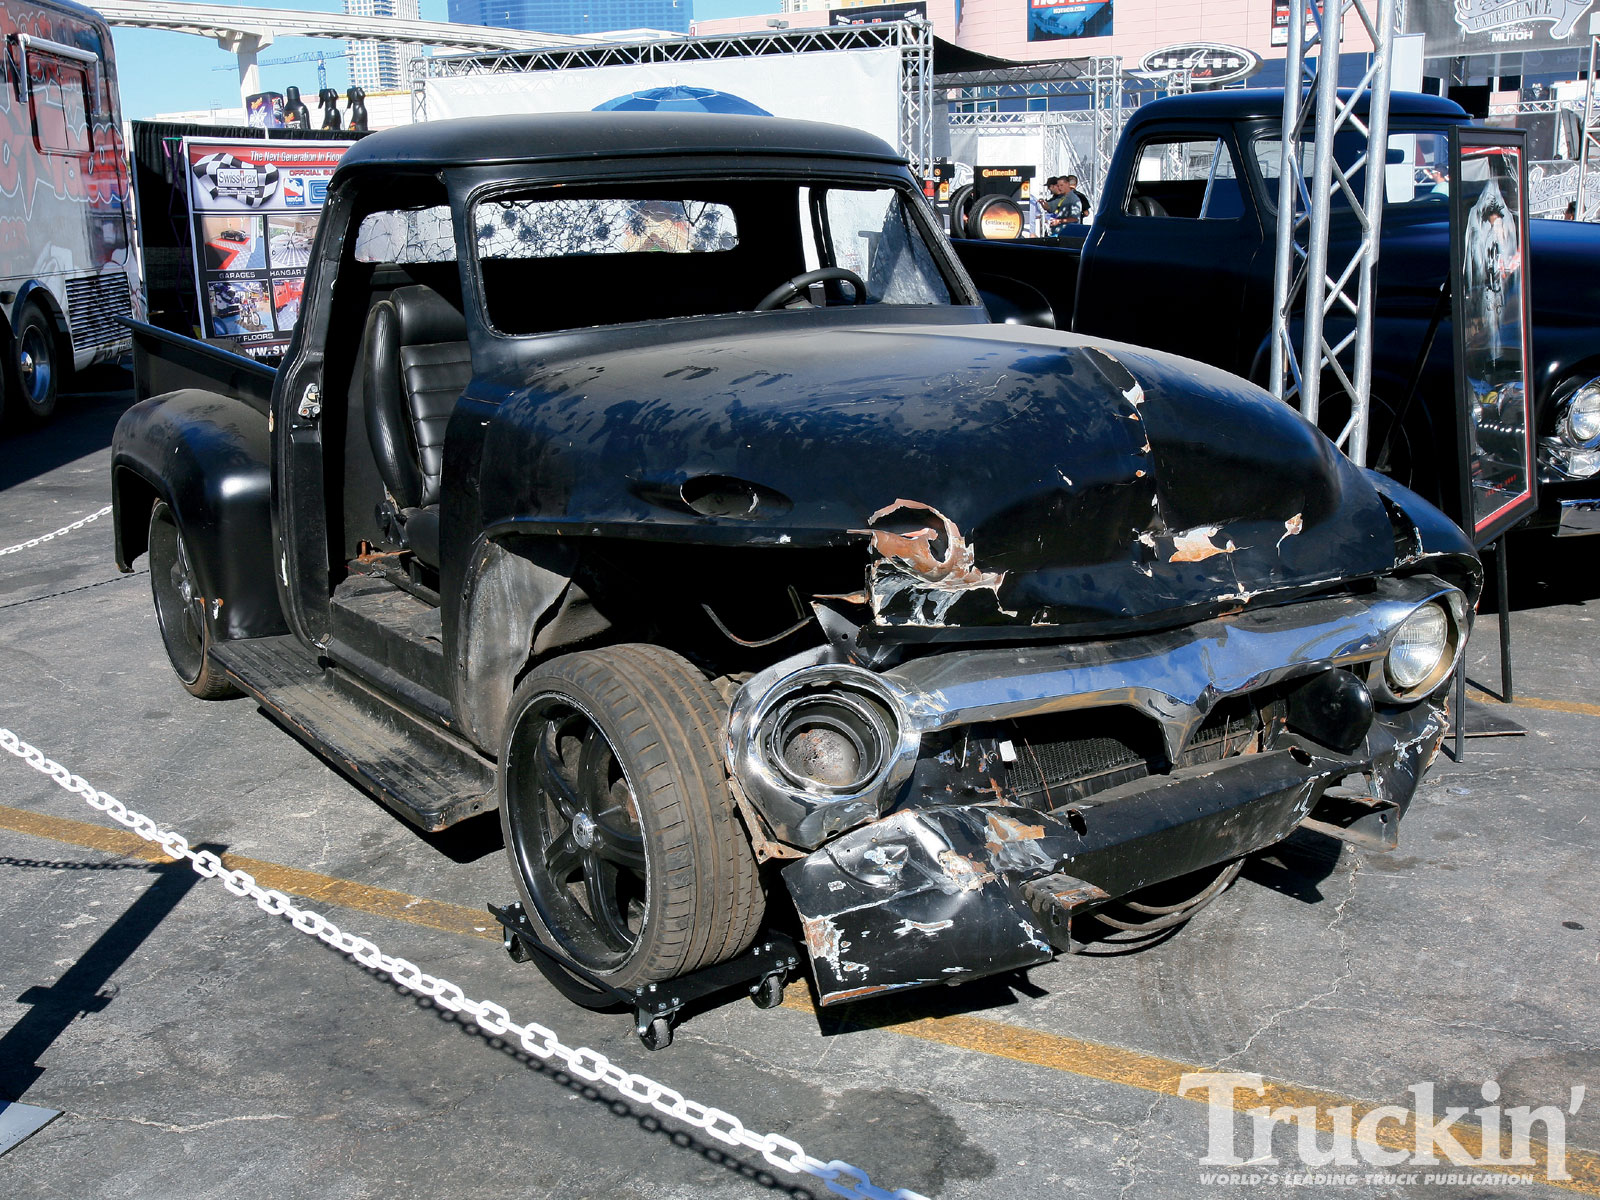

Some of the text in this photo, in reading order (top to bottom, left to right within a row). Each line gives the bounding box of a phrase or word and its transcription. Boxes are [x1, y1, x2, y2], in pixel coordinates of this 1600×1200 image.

[1474, 0, 1552, 28] EXPERIENCE
[1491, 30, 1533, 42] MUTOH
[1153, 58, 1240, 69] FESLER
[251, 150, 263, 162] The
[264, 151, 279, 163] Next
[281, 151, 317, 163] Generation
[318, 152, 325, 162] In
[289, 169, 321, 177] OFFICIAL
[982, 169, 1017, 178] Continental
[219, 271, 256, 279] GARAGES
[243, 333, 274, 342] FLOORS
